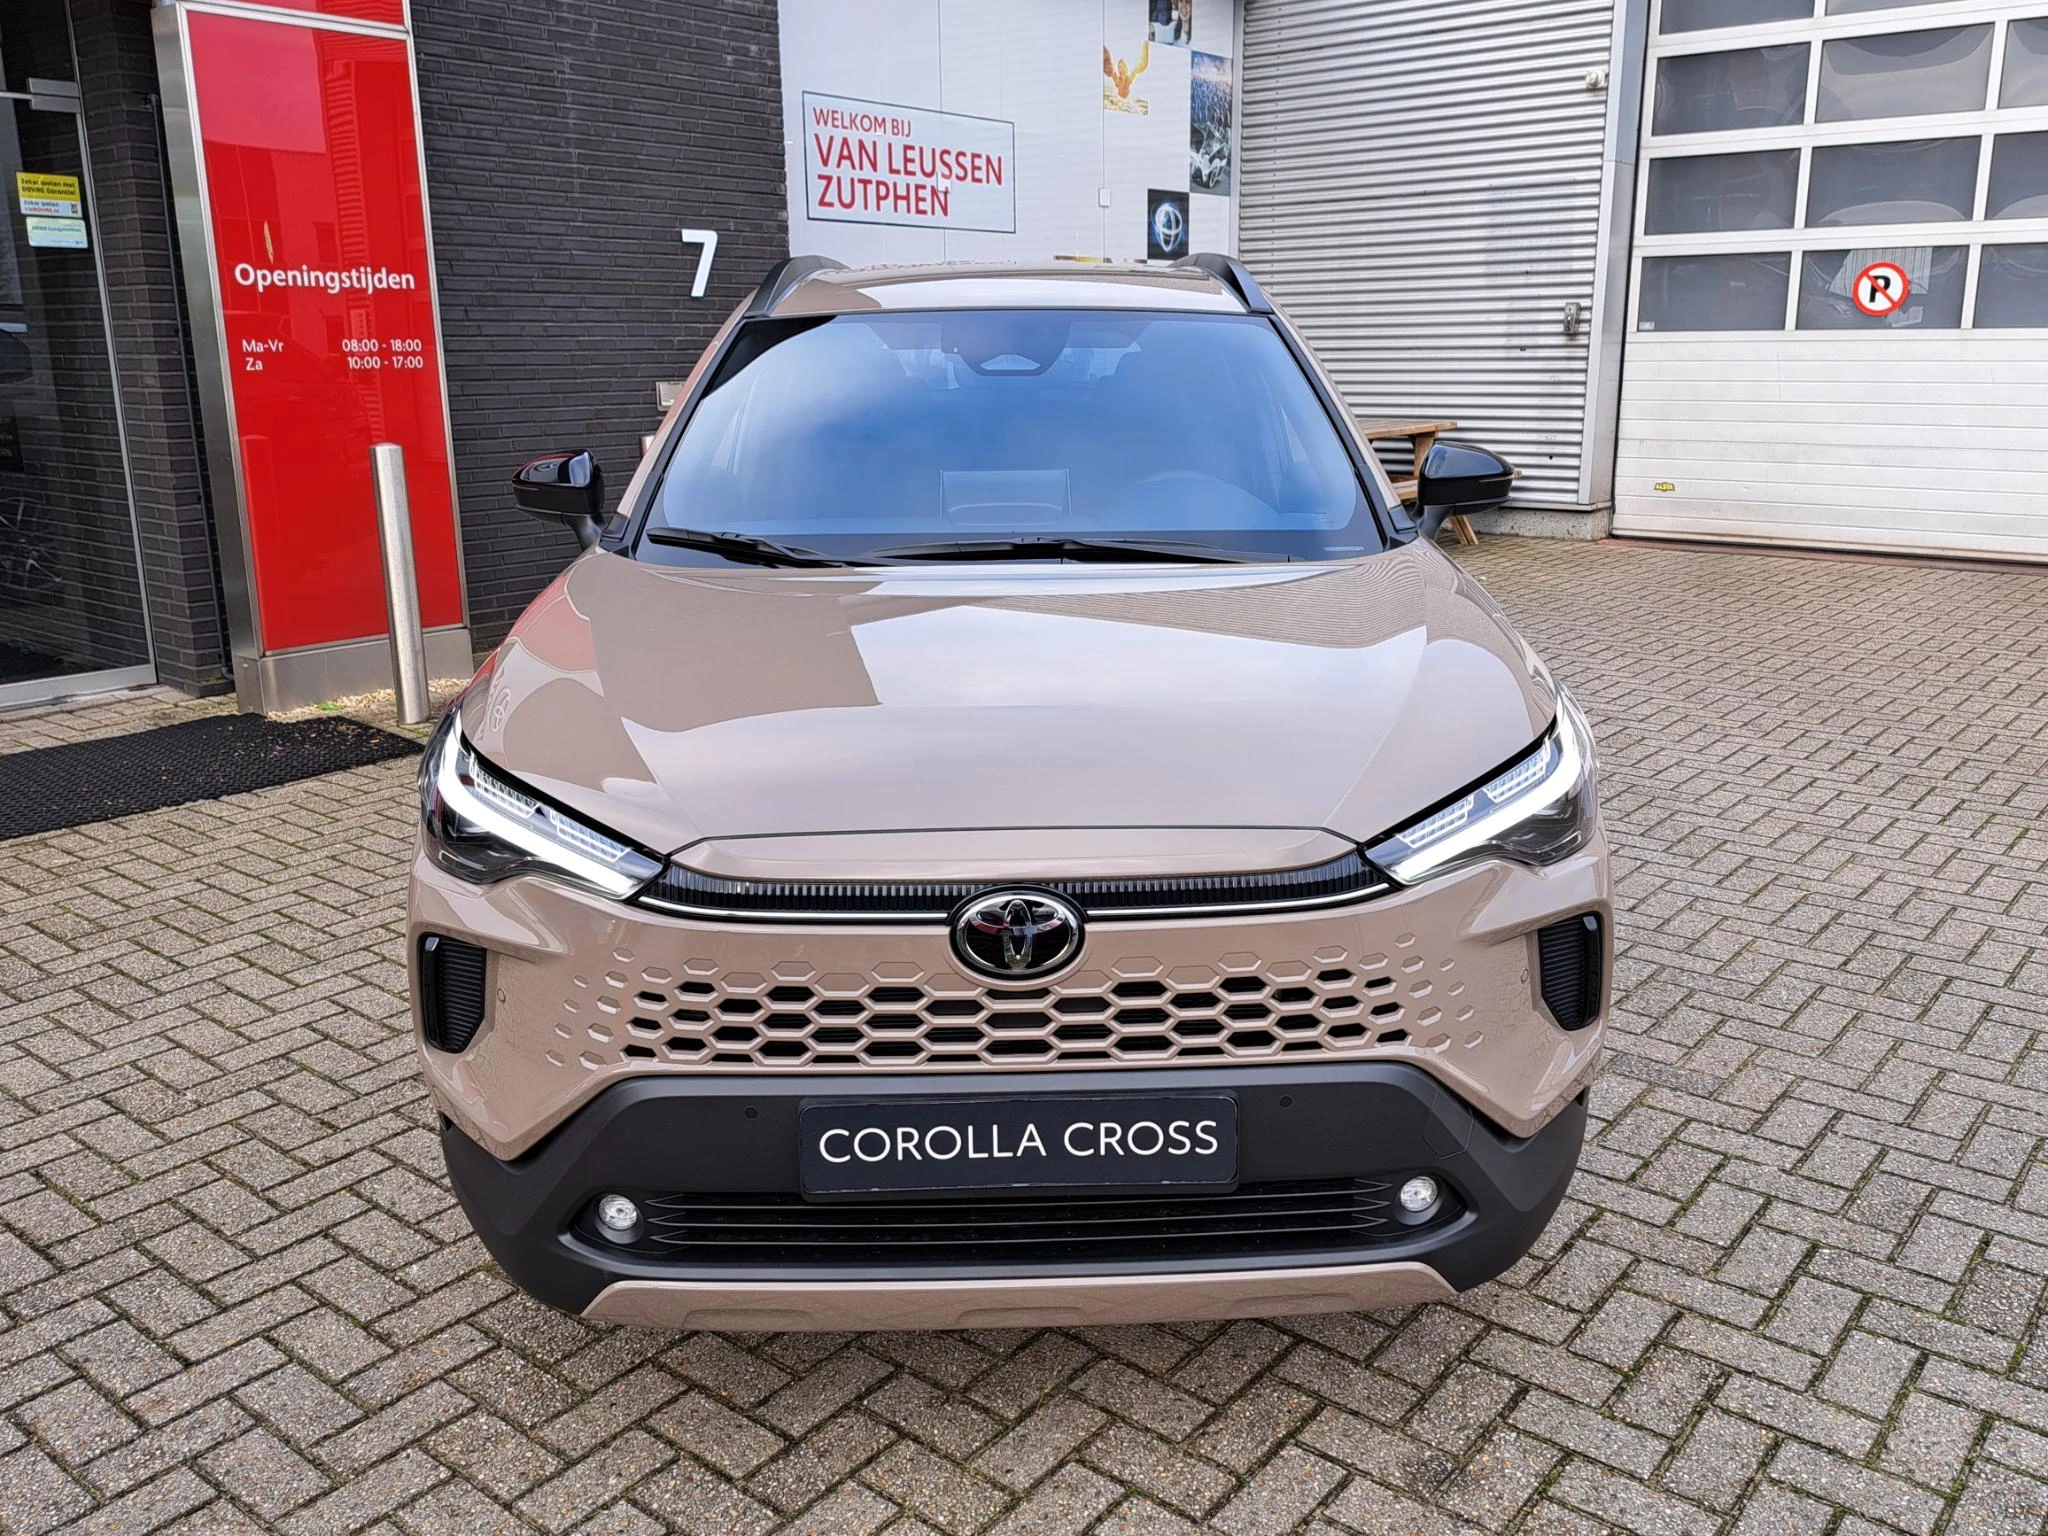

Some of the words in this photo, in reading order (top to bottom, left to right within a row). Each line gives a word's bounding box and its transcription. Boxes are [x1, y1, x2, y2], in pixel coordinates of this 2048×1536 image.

[812, 106, 887, 135] WELKOM
[891, 118, 912, 138] BIJ
[813, 132, 879, 174] VAN
[887, 141, 1003, 187] LEUSSEN
[816, 173, 949, 217] ZUTPHEN
[234, 262, 416, 295] Openingstijden
[681, 228, 719, 297] 7
[241, 338, 285, 353] Ma-Vr
[341, 338, 379, 352] 08:00
[389, 338, 422, 352] 18:00
[245, 357, 264, 371] Za
[347, 355, 381, 370] 10:00
[391, 355, 424, 369] 17:00
[818, 1122, 1048, 1164] COROLLA
[1062, 1119, 1219, 1157] CROSS
